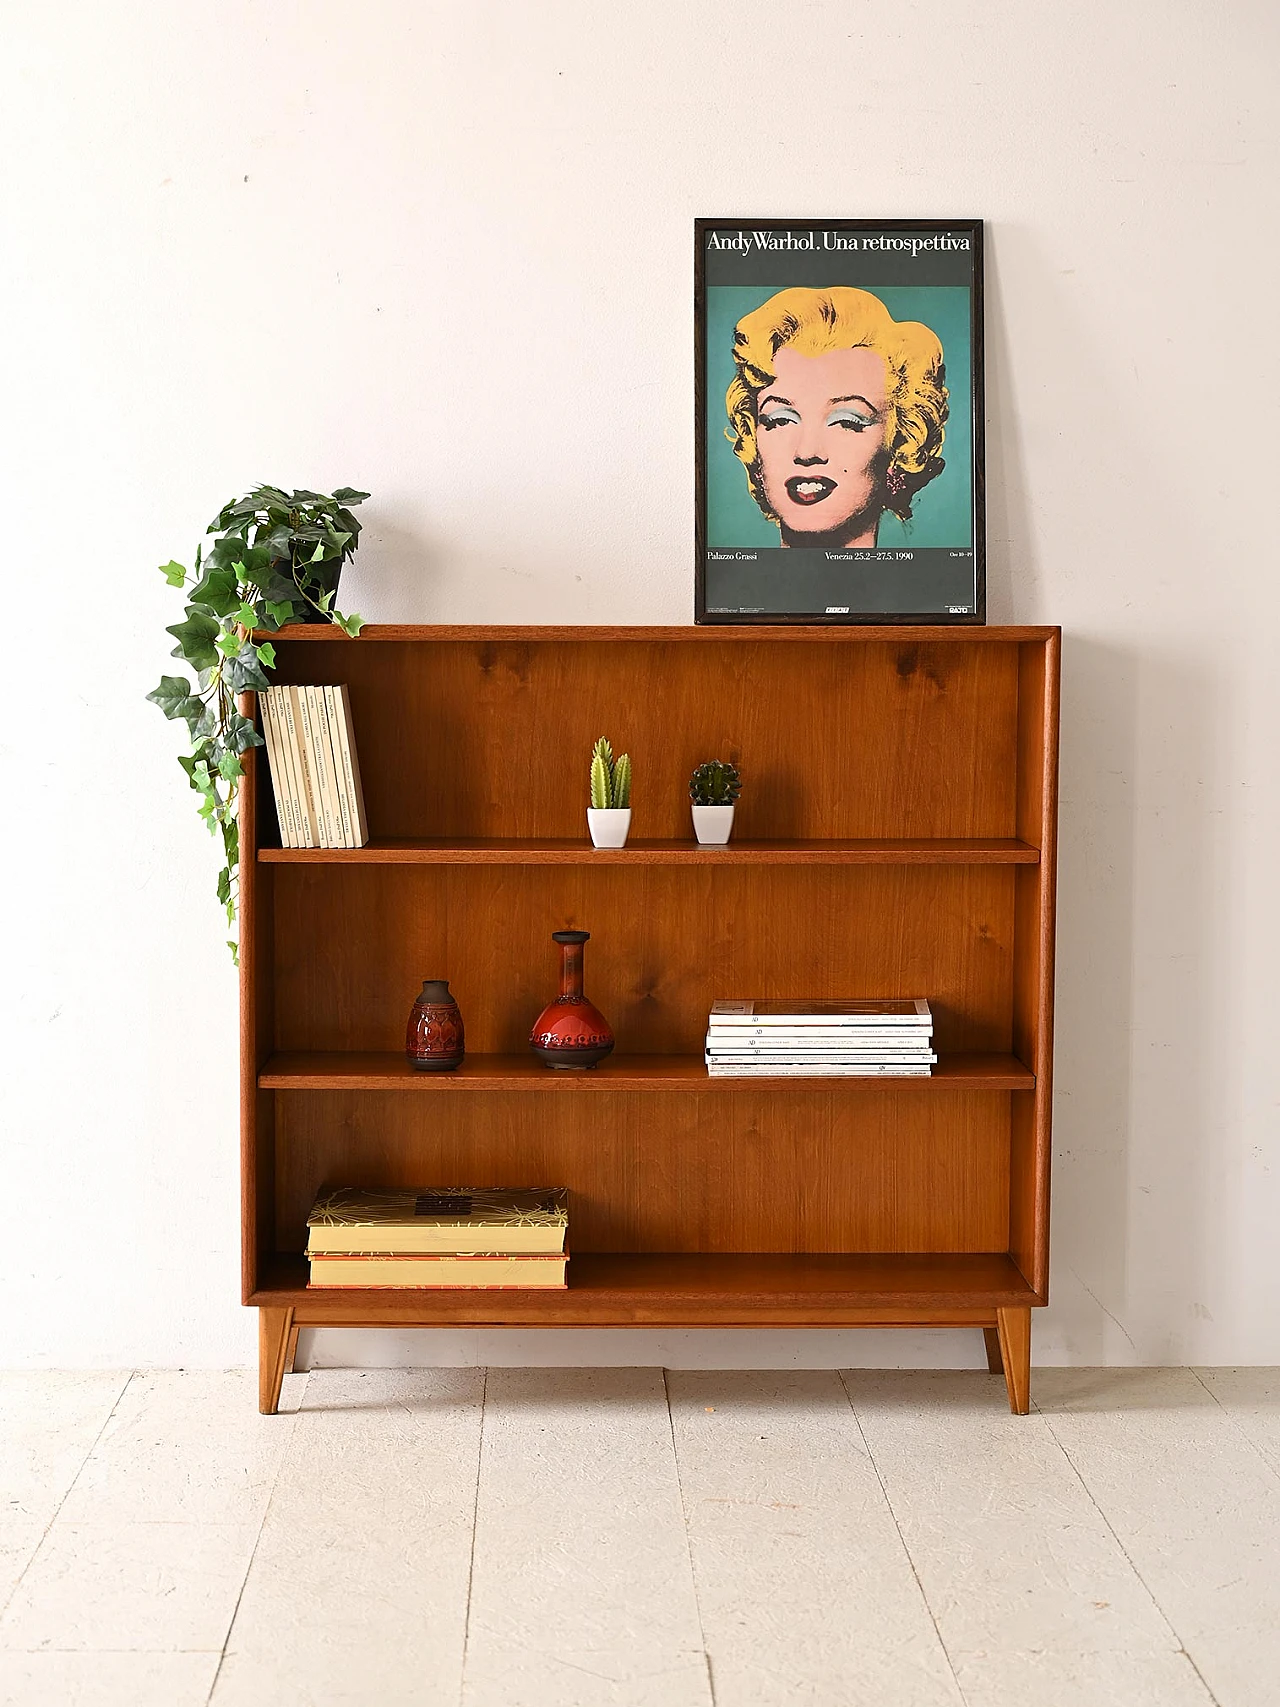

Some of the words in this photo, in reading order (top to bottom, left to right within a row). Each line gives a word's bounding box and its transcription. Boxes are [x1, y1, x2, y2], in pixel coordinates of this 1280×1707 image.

[706, 231, 753, 257] Andy
[751, 231, 820, 251] Warhol.
[822, 232, 858, 251] Una
[861, 232, 971, 257] retrospettiva
[706, 551, 735, 561] Palazzo
[735, 551, 758, 561] Grassi
[824, 551, 854, 561] Venezia
[896, 551, 914, 561] 1990
